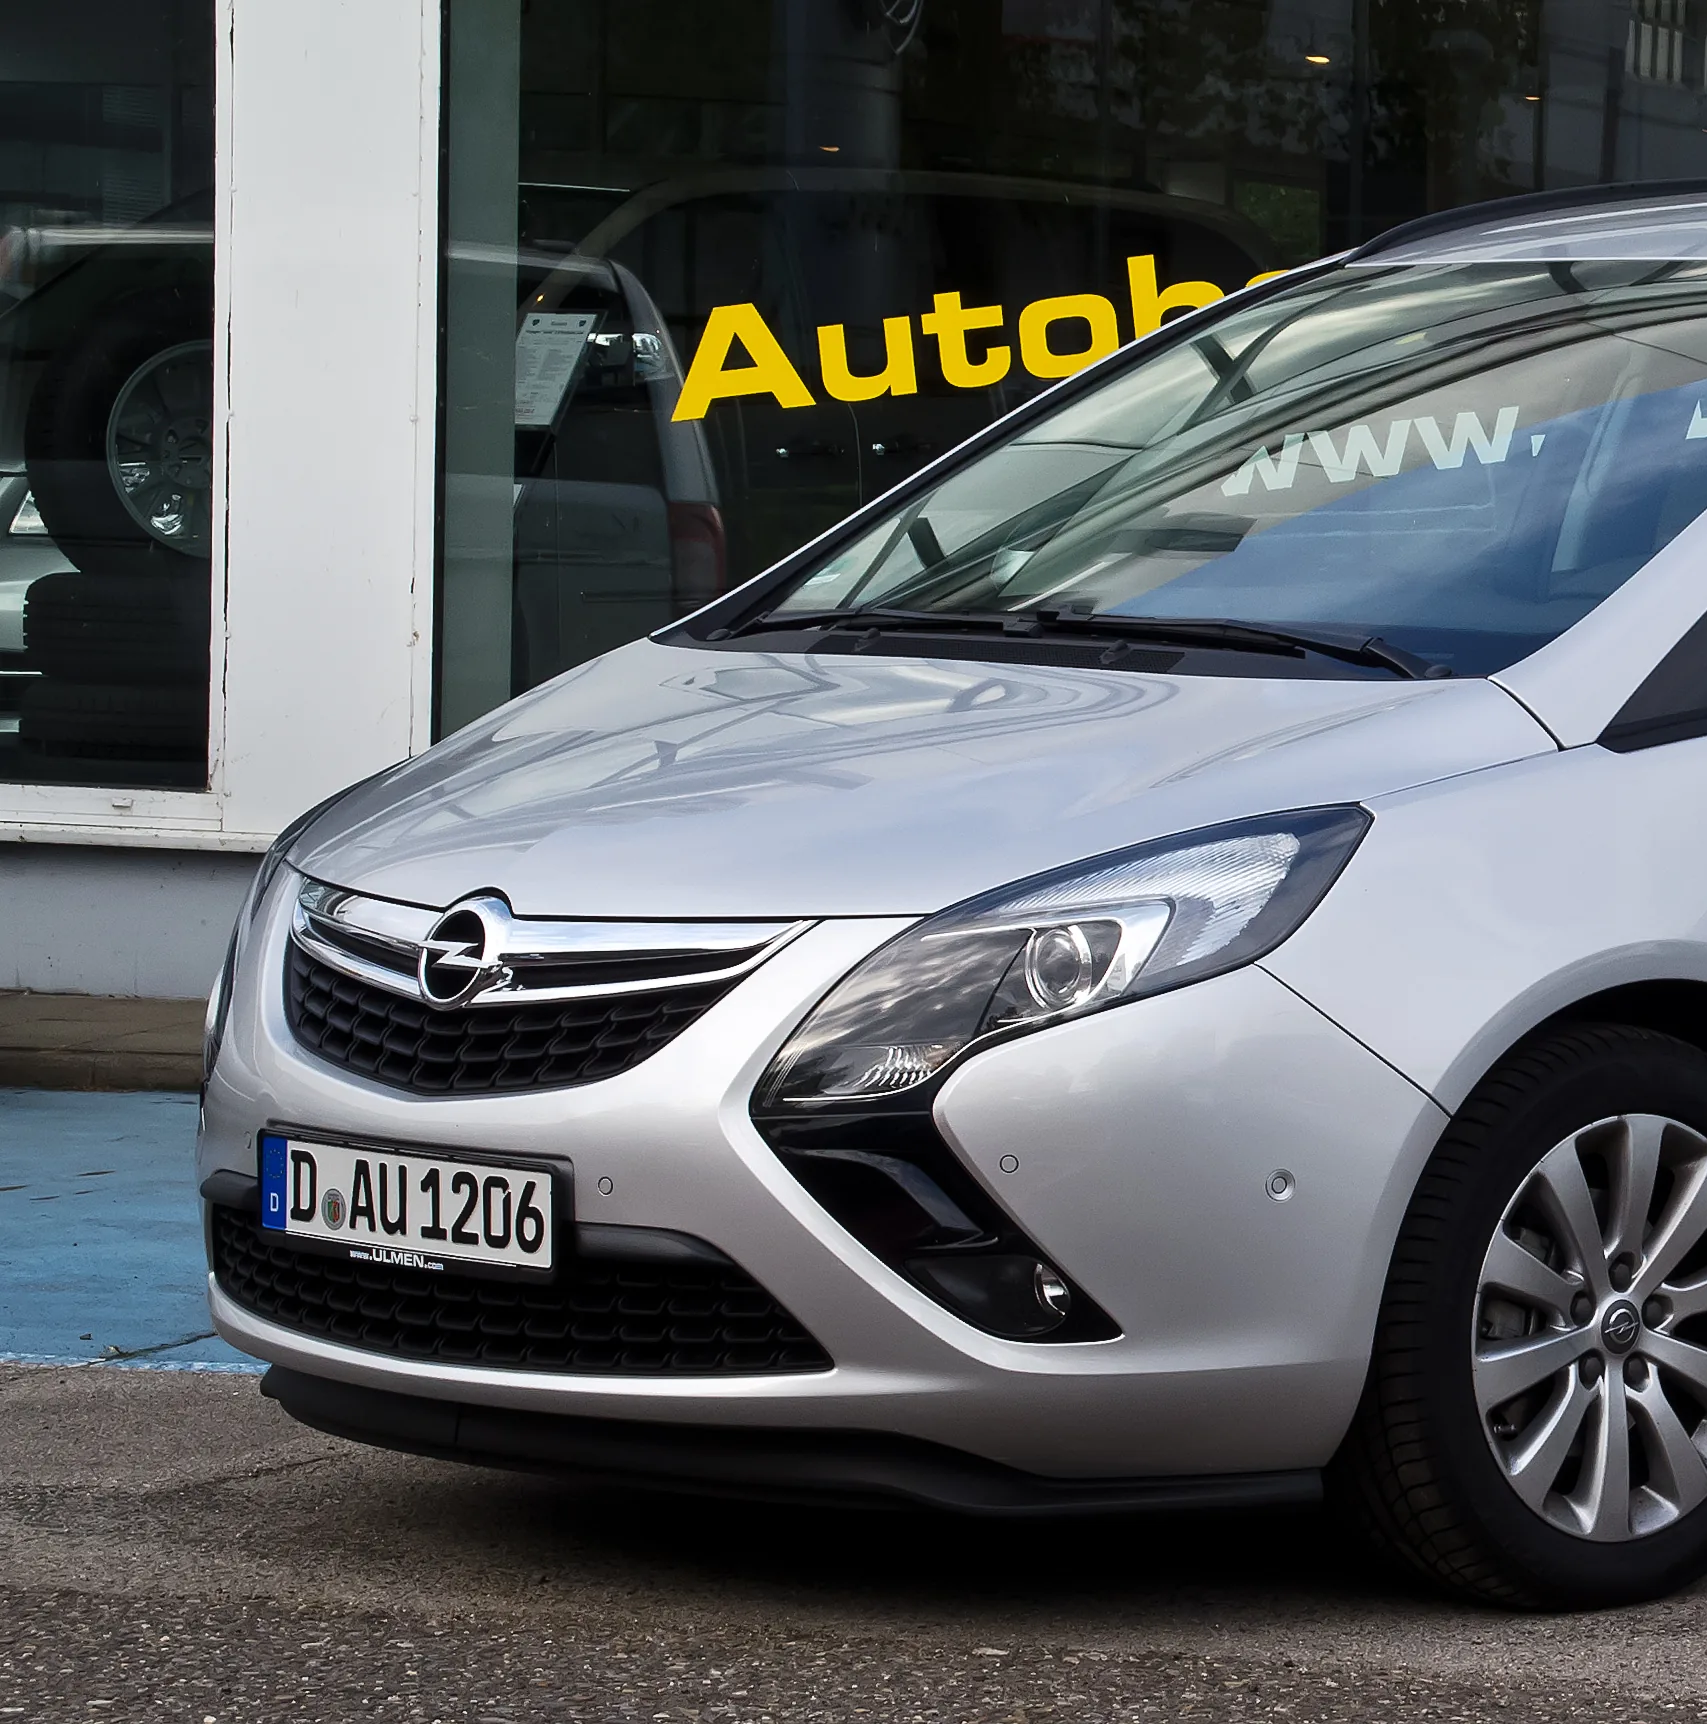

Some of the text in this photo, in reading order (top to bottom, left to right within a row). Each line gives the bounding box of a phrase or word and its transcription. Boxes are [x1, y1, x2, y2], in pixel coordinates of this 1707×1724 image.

[670, 254, 1290, 423] Autoh
[270, 1192, 279, 1213] D
[290, 1149, 545, 1254] D AU 1206
